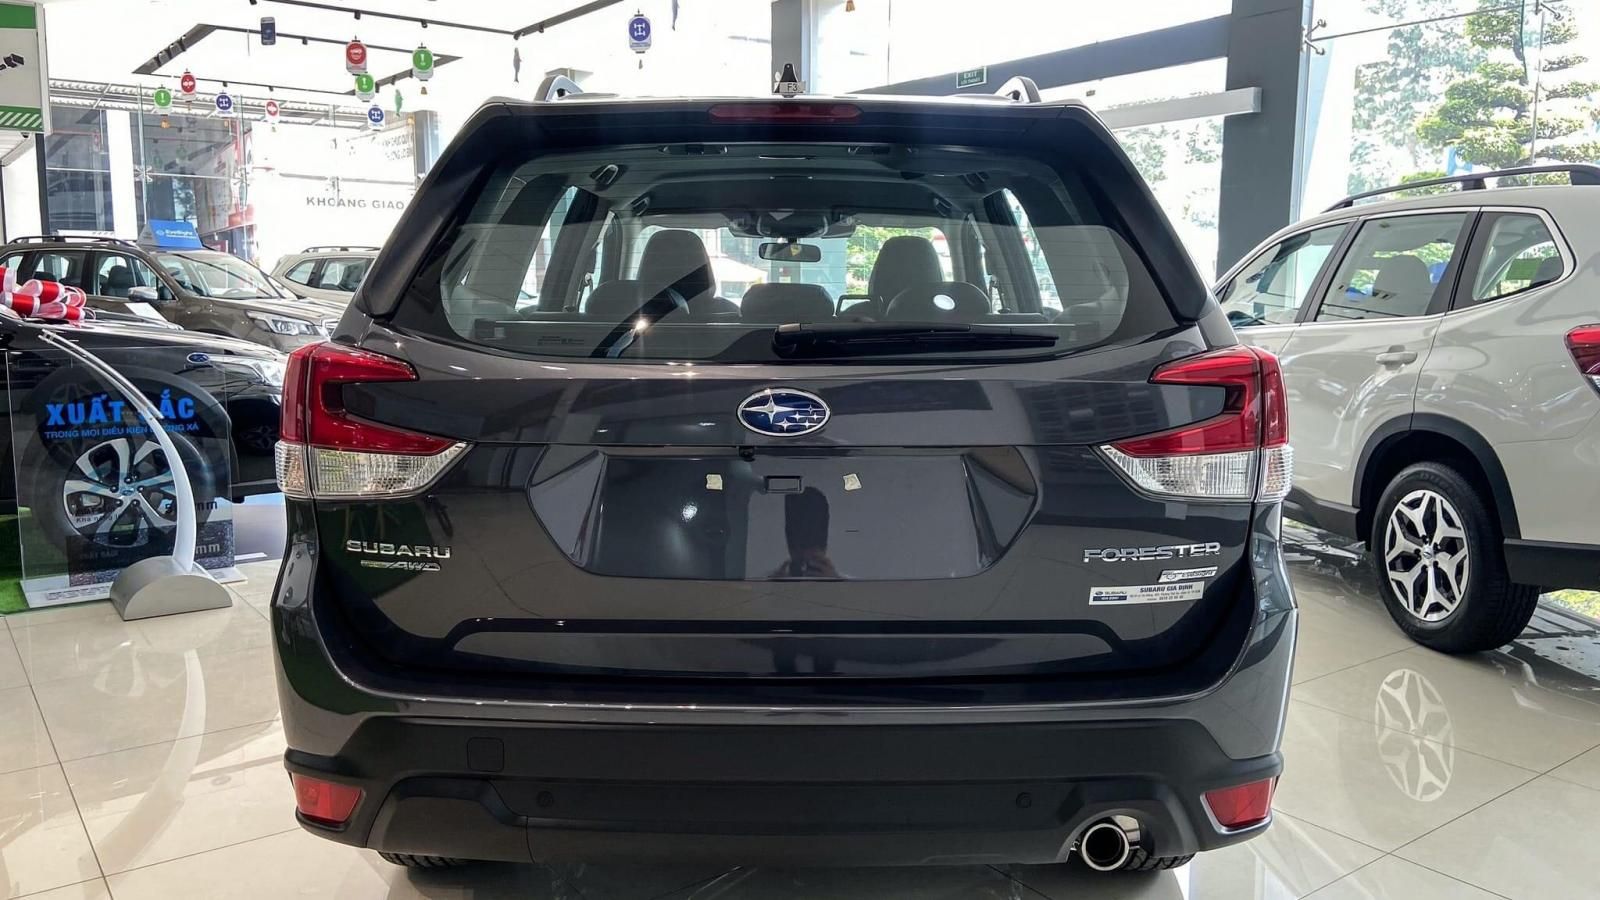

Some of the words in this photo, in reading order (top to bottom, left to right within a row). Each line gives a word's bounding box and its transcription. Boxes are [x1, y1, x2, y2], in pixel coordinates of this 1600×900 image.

[371, 199, 405, 210] GIAO
[46, 394, 125, 426] XUẤT
[138, 389, 195, 420] ẮC
[44, 430, 80, 440] TRONG
[346, 539, 451, 559] SUBARU
[1083, 541, 1221, 563] FORESTER
